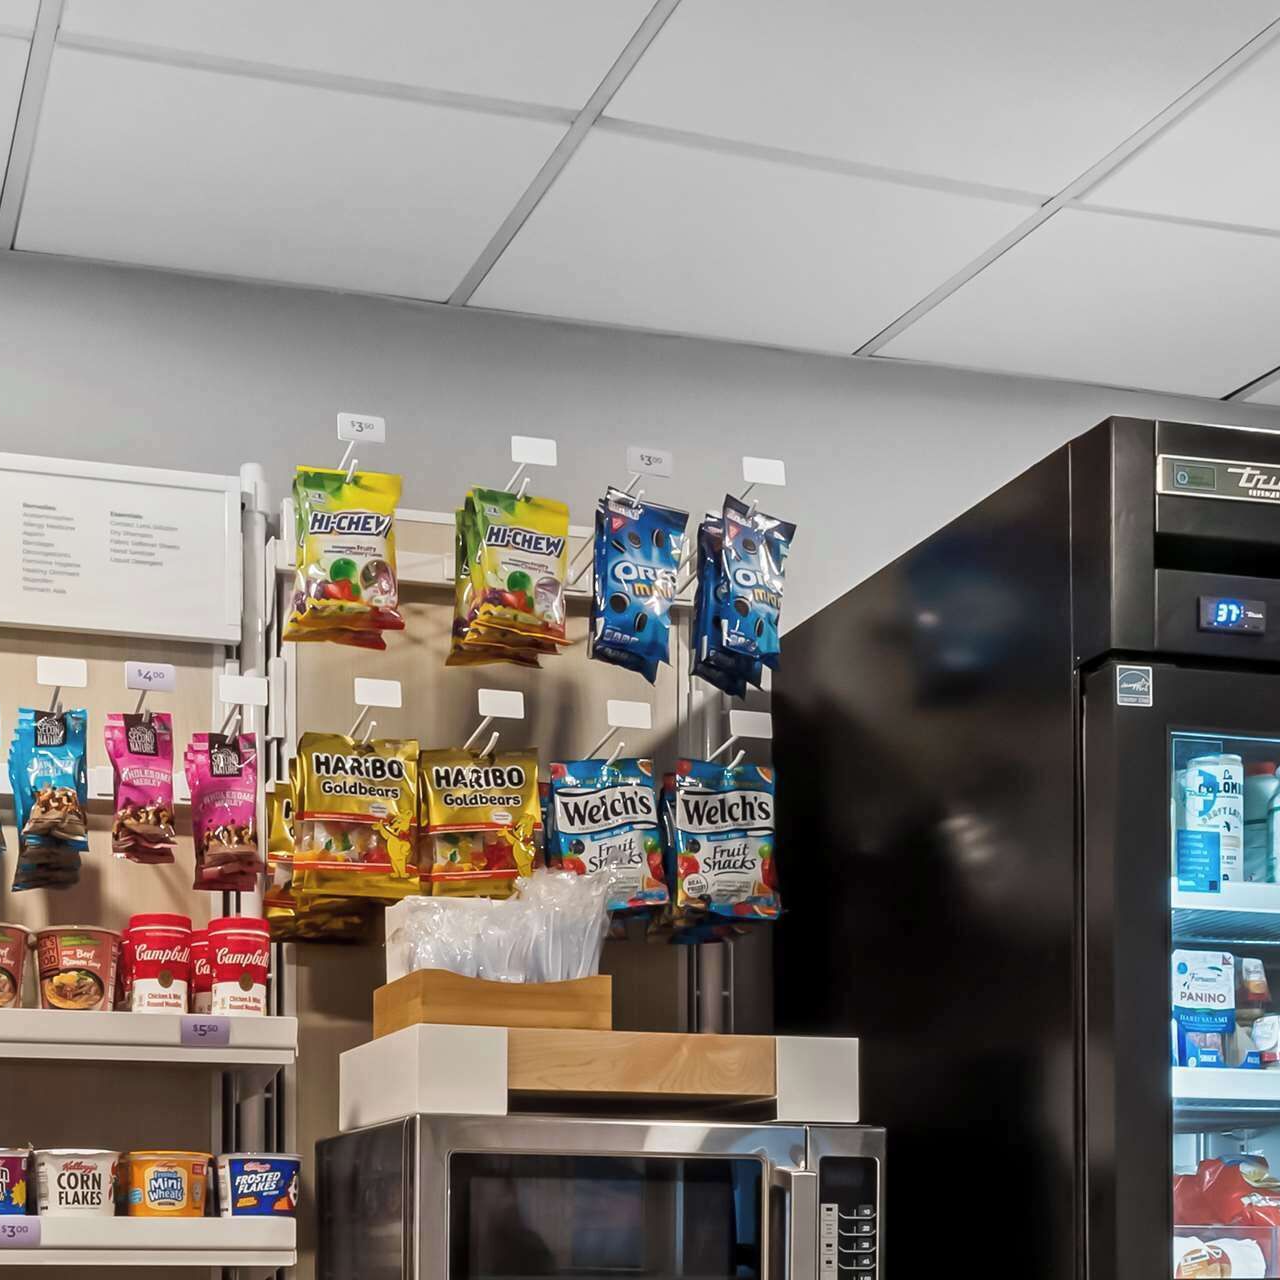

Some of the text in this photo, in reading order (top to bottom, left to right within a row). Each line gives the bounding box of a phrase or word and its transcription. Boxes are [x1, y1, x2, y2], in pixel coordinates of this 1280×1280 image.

[310, 512, 392, 535] HI-CHEW
[486, 525, 563, 555] HI-CHEW
[1217, 604, 1240, 622] 37
[128, 729, 154, 743] SECOND
[130, 741, 155, 754] NATURE
[213, 764, 239, 775] NATURE
[313, 753, 405, 780] HARIBO
[133, 778, 160, 788] MEDLEY
[434, 766, 525, 789] HARIBO
[322, 781, 399, 799] Goldbears
[444, 793, 521, 807] Goldbears
[562, 792, 652, 827] Welch's
[681, 796, 770, 825] Welch's
[711, 844, 749, 860] Fruit
[702, 856, 757, 873] Snacks
[76, 949, 95, 959] Beef
[62, 957, 86, 966] Ramen
[1180, 991, 1227, 1004] PANINO
[62, 1161, 97, 1173] Kellogg's
[57, 1172, 101, 1190] CORN
[150, 1177, 181, 1191] Mini
[235, 1172, 281, 1185] FROSTED
[238, 1181, 277, 1193] FLAKES
[58, 1190, 101, 1206] FLAKES
[148, 1189, 183, 1200] Wheats
